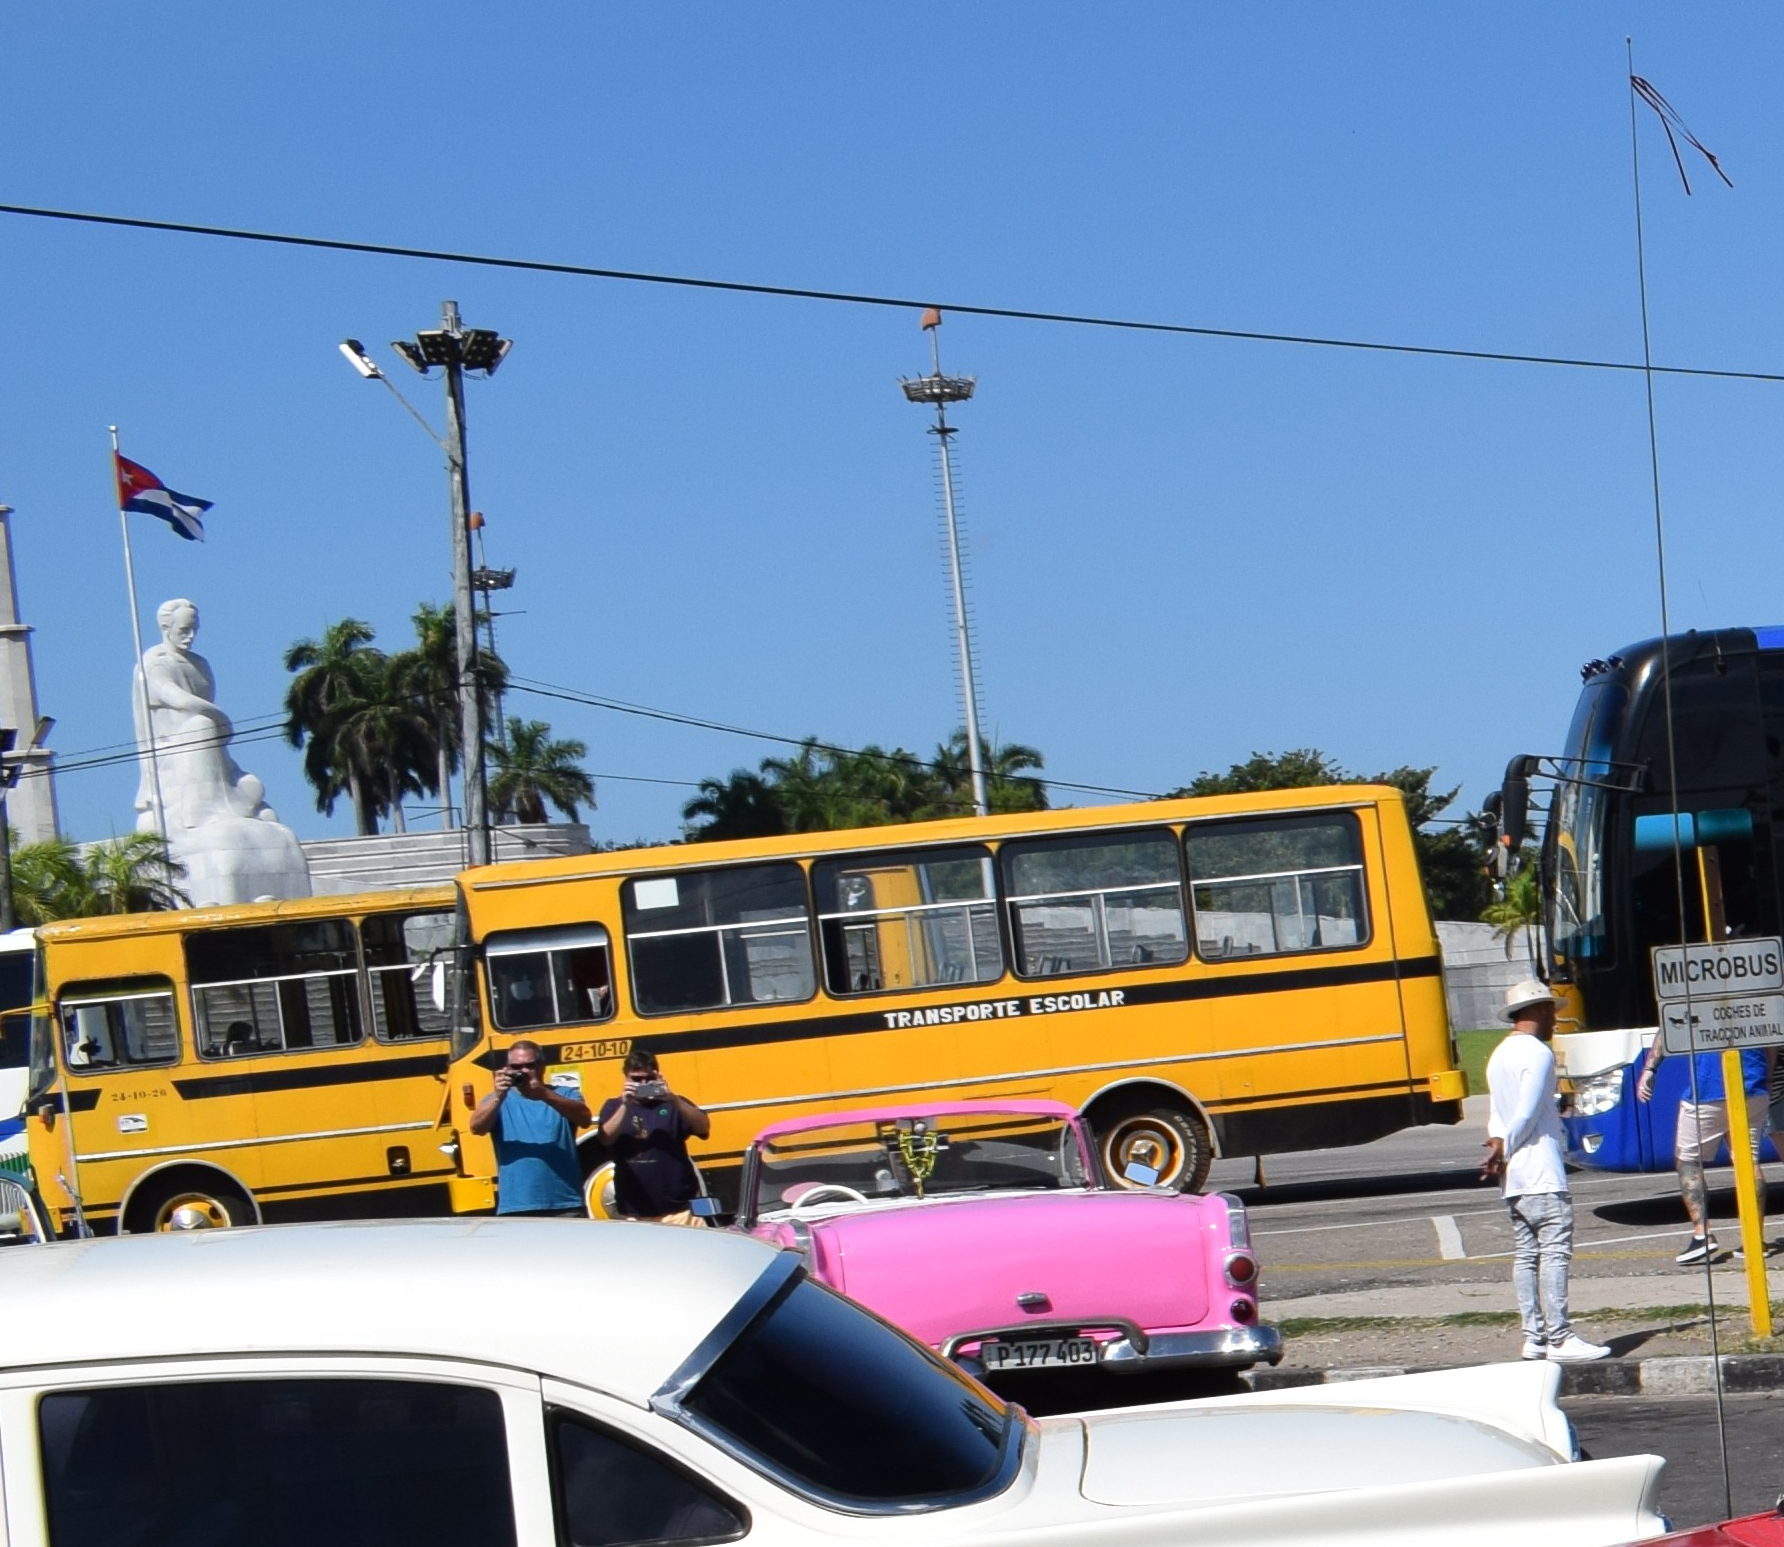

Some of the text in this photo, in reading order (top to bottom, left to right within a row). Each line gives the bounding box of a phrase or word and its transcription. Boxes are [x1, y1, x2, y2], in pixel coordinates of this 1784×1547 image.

[1660, 953, 1779, 985] MICROBUS
[883, 989, 1125, 1029] TRANSPORTE ESCOLAR
[1713, 1003, 1767, 1021] COCHES DE
[1749, 1023, 1784, 1038] ANIMAL
[563, 1040, 629, 1061] 24-10-10
[997, 1345, 1010, 1368] P
[1014, 1343, 1051, 1367] 177
[1057, 1341, 1093, 1364] 403
